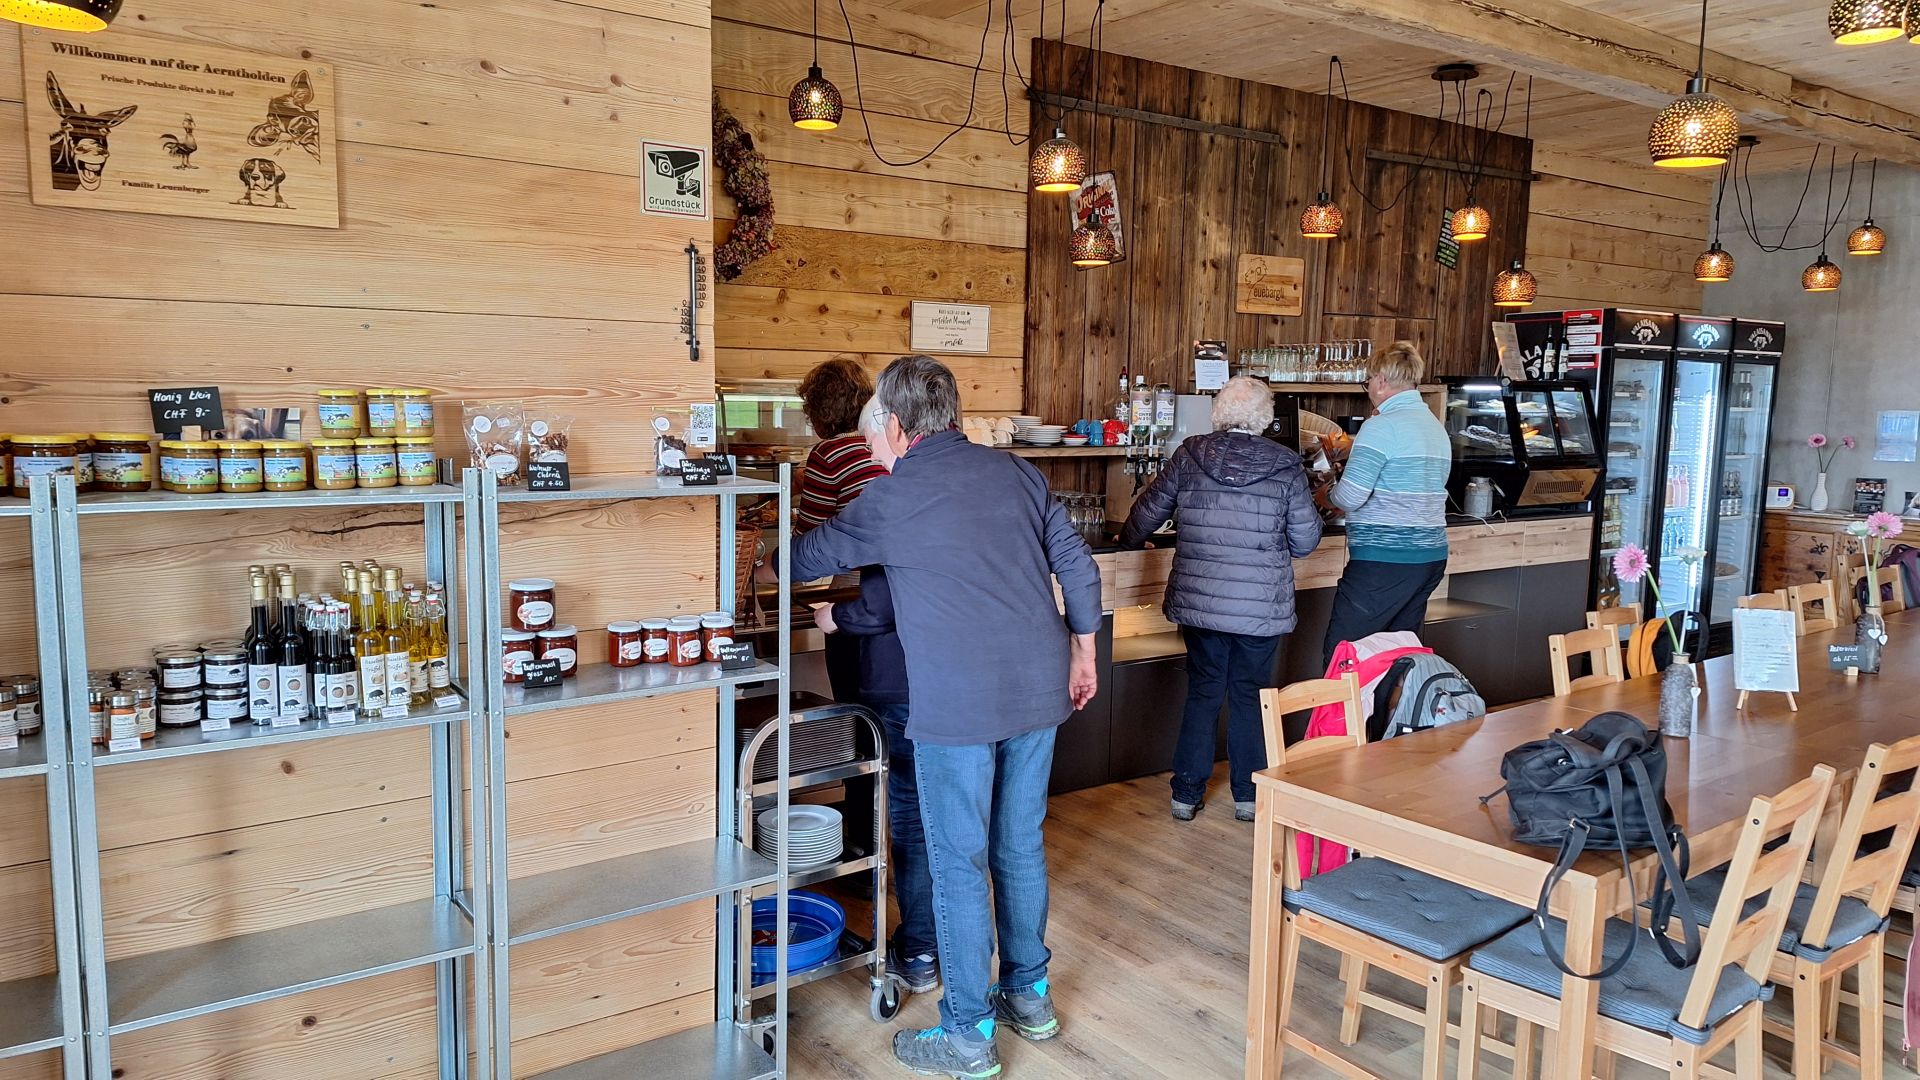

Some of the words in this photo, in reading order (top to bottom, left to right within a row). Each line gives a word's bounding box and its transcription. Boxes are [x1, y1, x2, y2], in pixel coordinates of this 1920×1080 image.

[51, 42, 147, 64] Willkommen
[150, 58, 175, 68] auf
[177, 60, 200, 71] der
[203, 63, 286, 83] Aerntholden
[101, 74, 135, 84] Frische
[137, 79, 176, 89] Produkte
[178, 84, 204, 93] direkt
[218, 89, 235, 97] Hof
[121, 180, 154, 189] Familie
[156, 183, 210, 194] Leuenberger
[649, 196, 701, 210] Grundstück
[153, 392, 182, 404] Honig
[188, 390, 211, 400] klein
[163, 409, 188, 419] CHF
